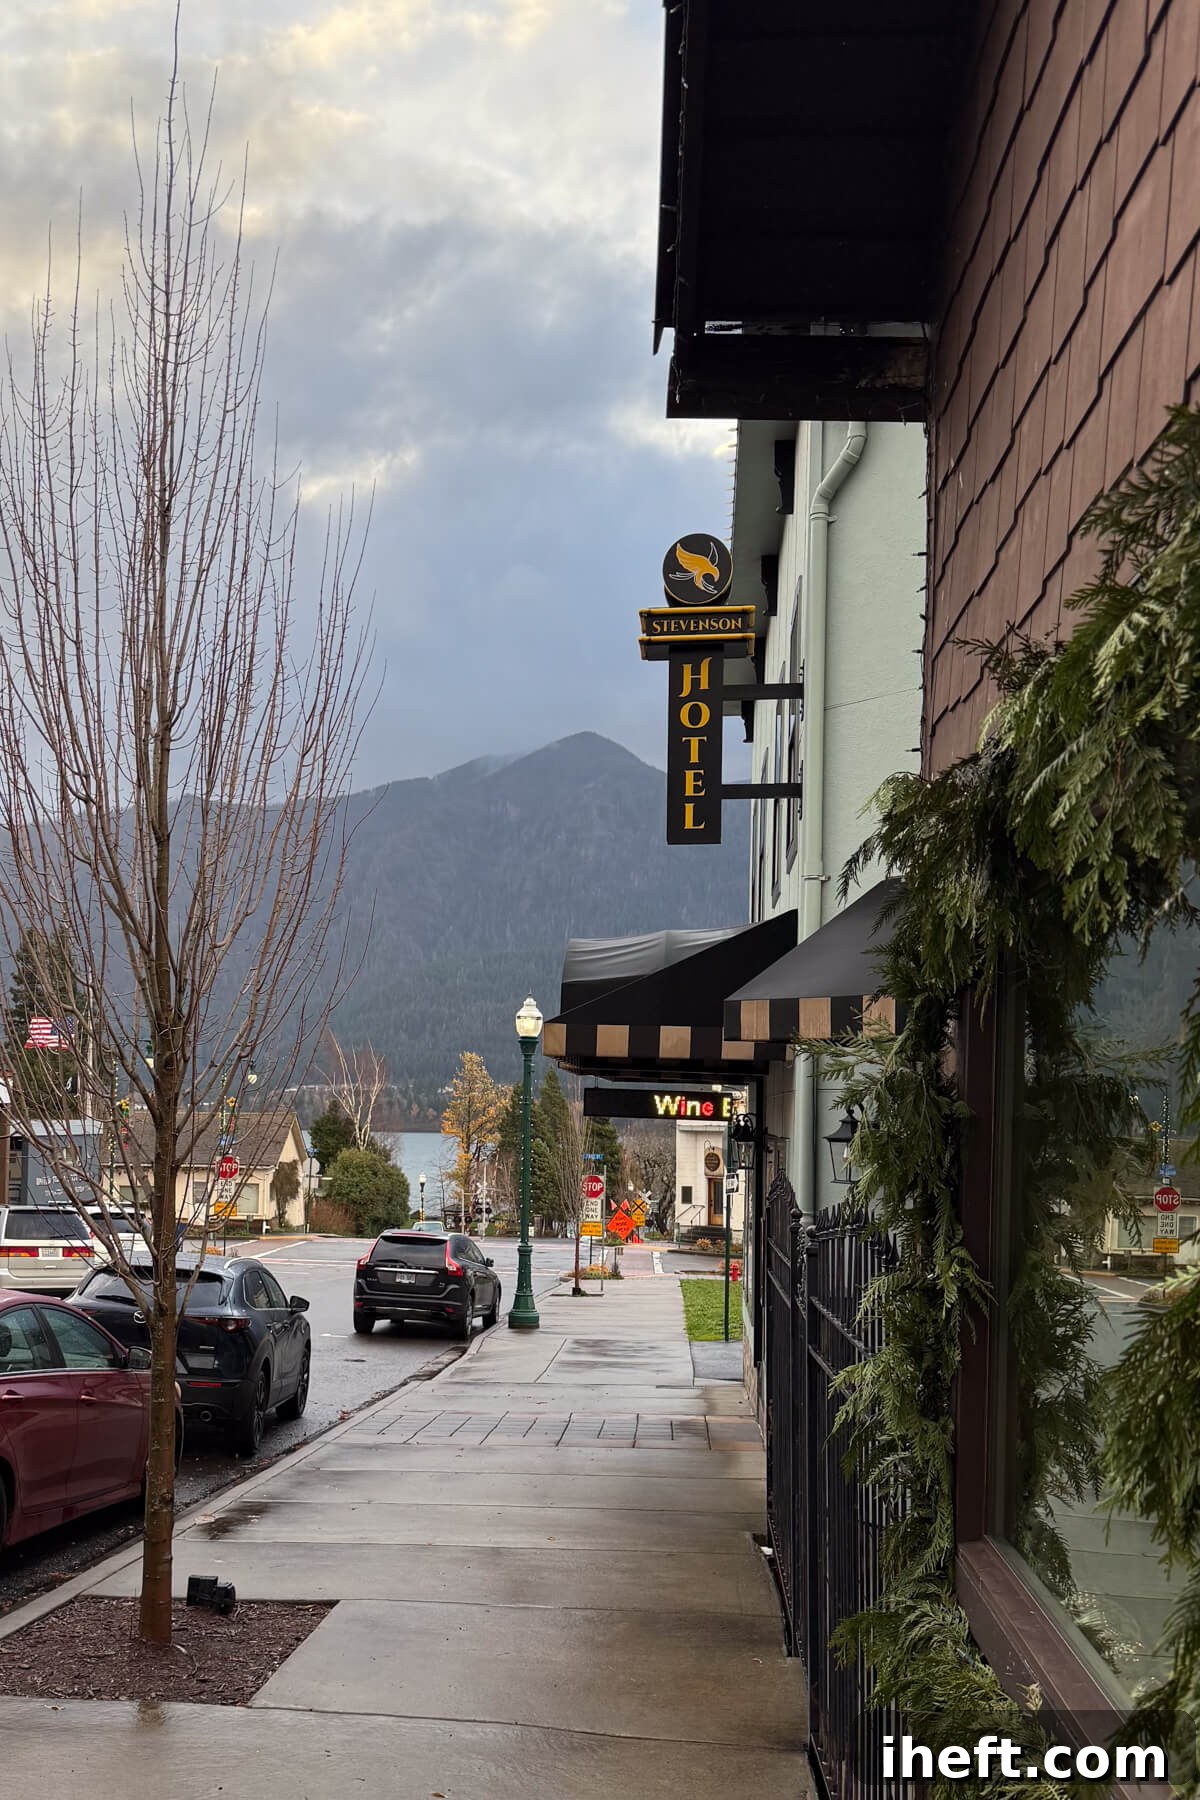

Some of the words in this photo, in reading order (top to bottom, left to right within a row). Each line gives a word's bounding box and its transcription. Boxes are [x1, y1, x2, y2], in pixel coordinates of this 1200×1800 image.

[651, 616, 743, 633] STEVENSON
[678, 657, 712, 830] HOTEL
[653, 1094, 714, 1117] Wine
[582, 1182, 603, 1192] STOP
